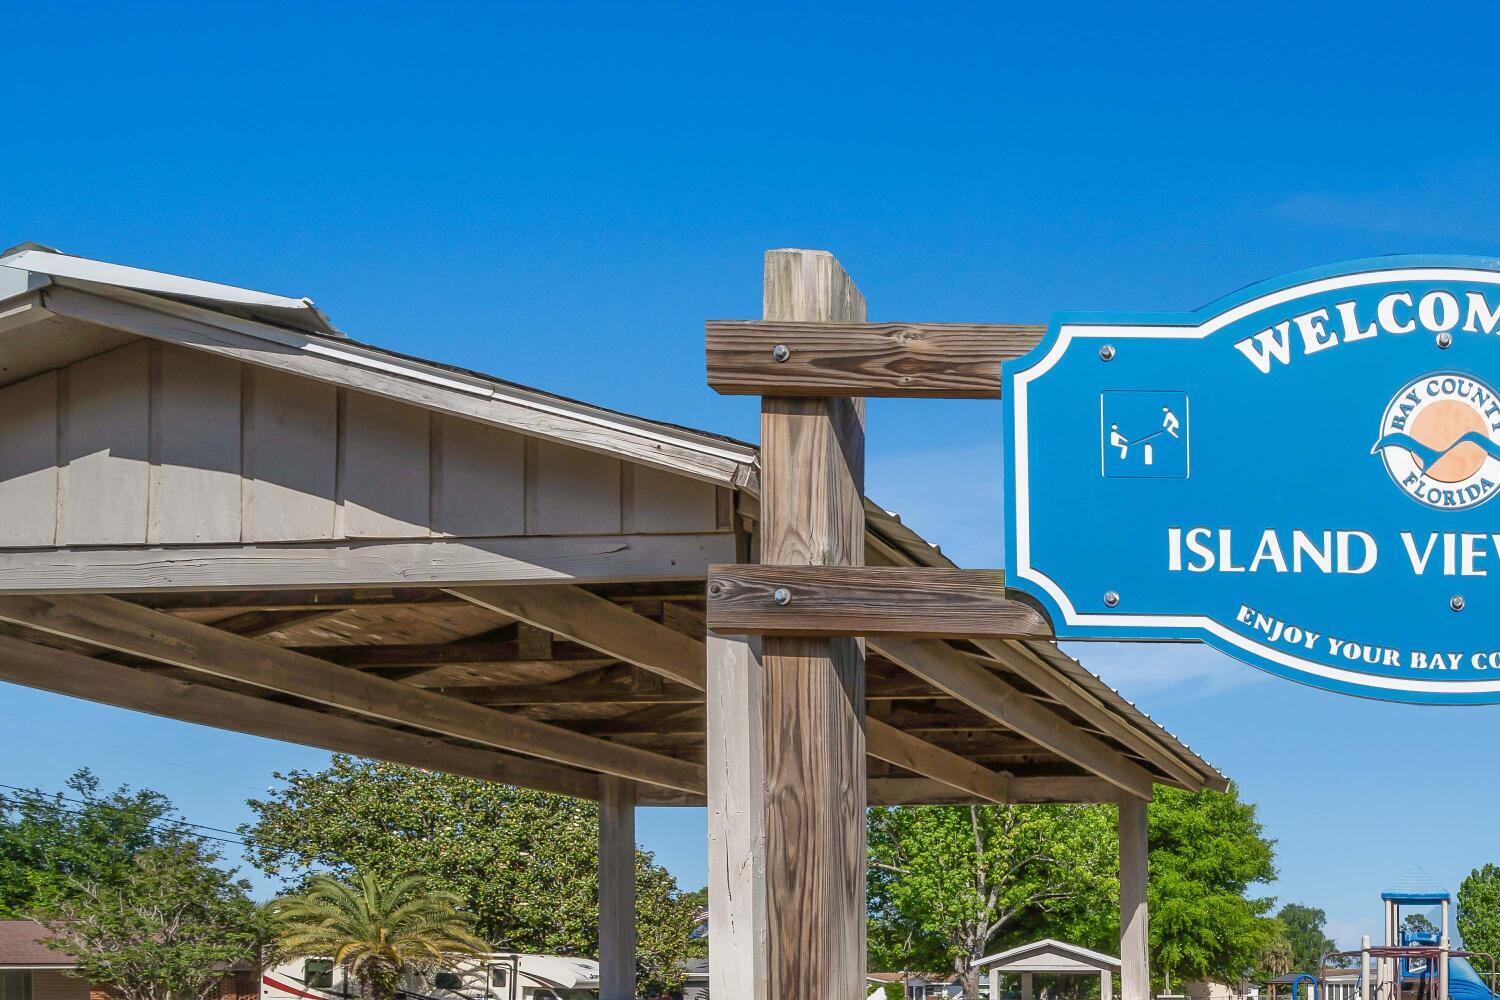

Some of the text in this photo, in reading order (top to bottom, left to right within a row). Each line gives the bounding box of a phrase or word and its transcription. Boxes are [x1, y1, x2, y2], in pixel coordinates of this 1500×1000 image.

[1391, 388, 1422, 432] BAY
[1402, 470, 1495, 506] FLORIDA
[1168, 527, 1378, 574] ISLAND
[1236, 605, 1320, 649] ENJOY
[1328, 637, 1402, 667] YOUR
[1410, 652, 1463, 670] BAY
